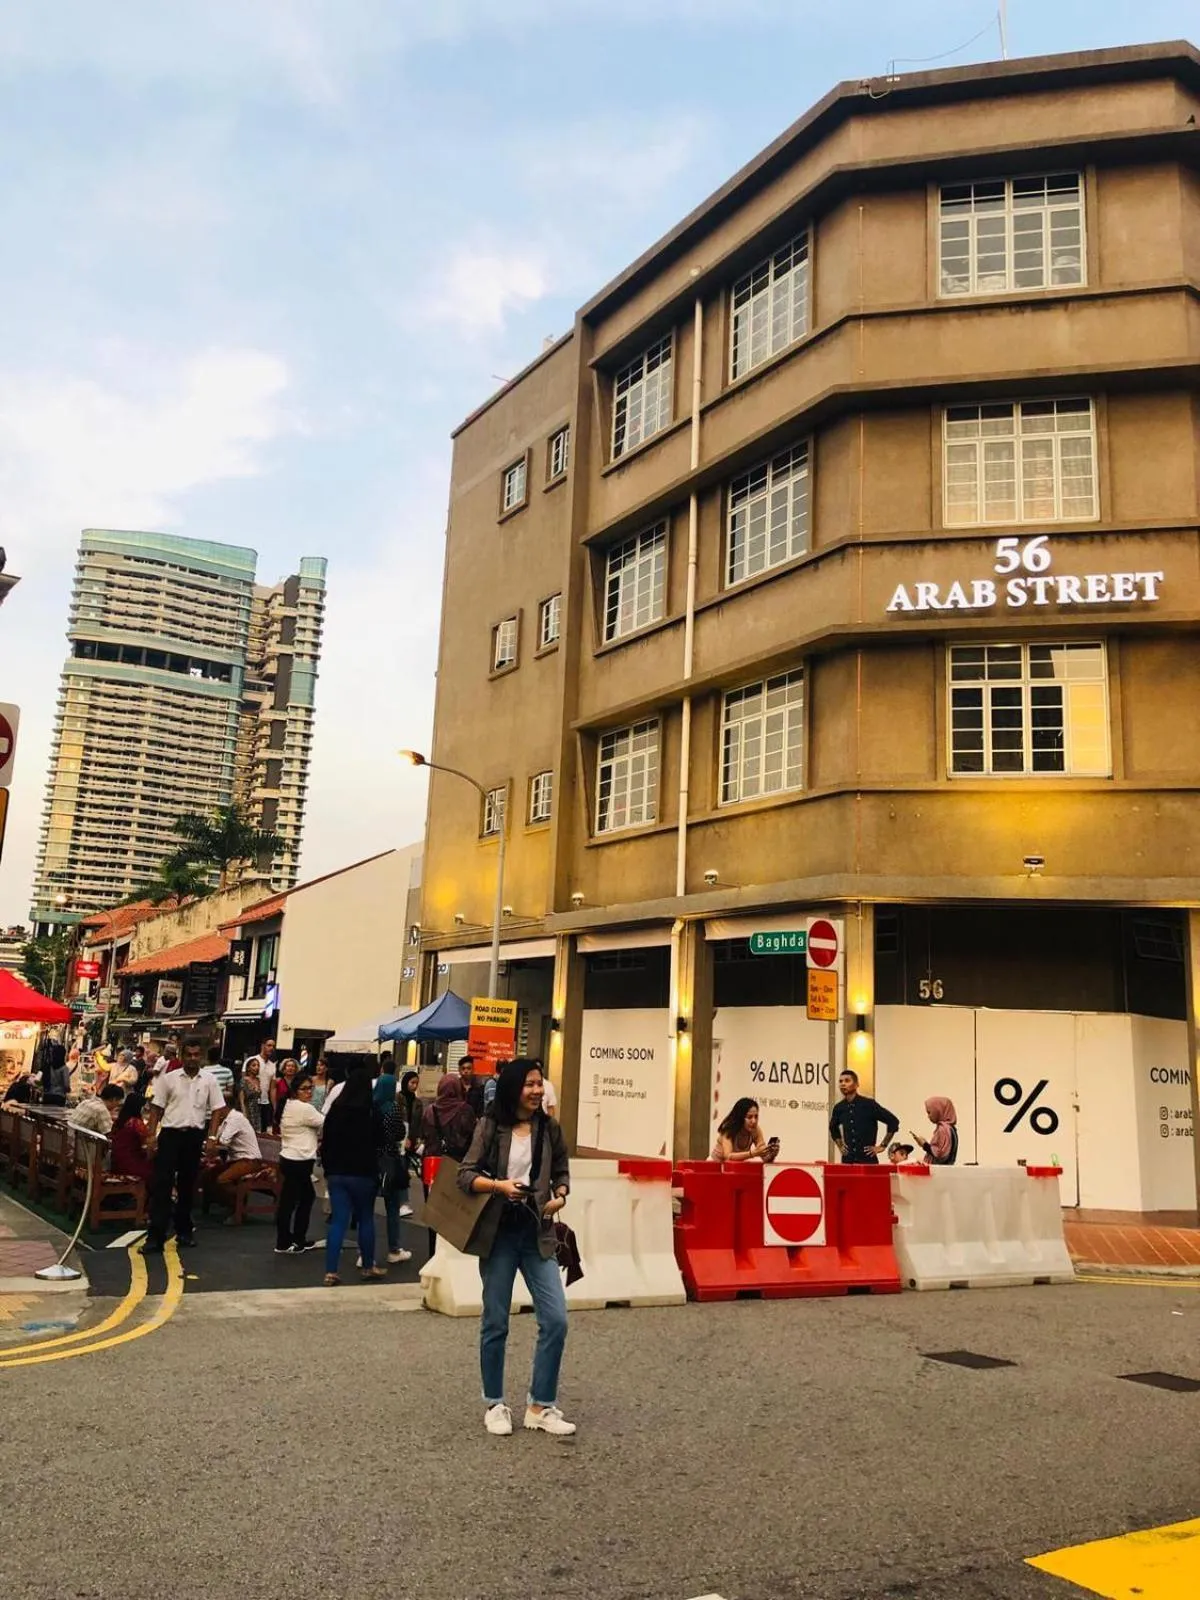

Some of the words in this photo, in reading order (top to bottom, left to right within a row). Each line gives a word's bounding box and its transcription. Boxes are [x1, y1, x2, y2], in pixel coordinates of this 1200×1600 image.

[994, 535, 1051, 574] 56
[886, 579, 997, 612] ARAB
[1006, 571, 1164, 607] STREET
[757, 933, 804, 951] Baghda
[919, 979, 944, 1000] 56
[475, 1005, 490, 1013] ROAD
[491, 1006, 513, 1015] CLOSURE
[590, 1046, 625, 1060] COMING
[627, 1047, 655, 1061] SOON
